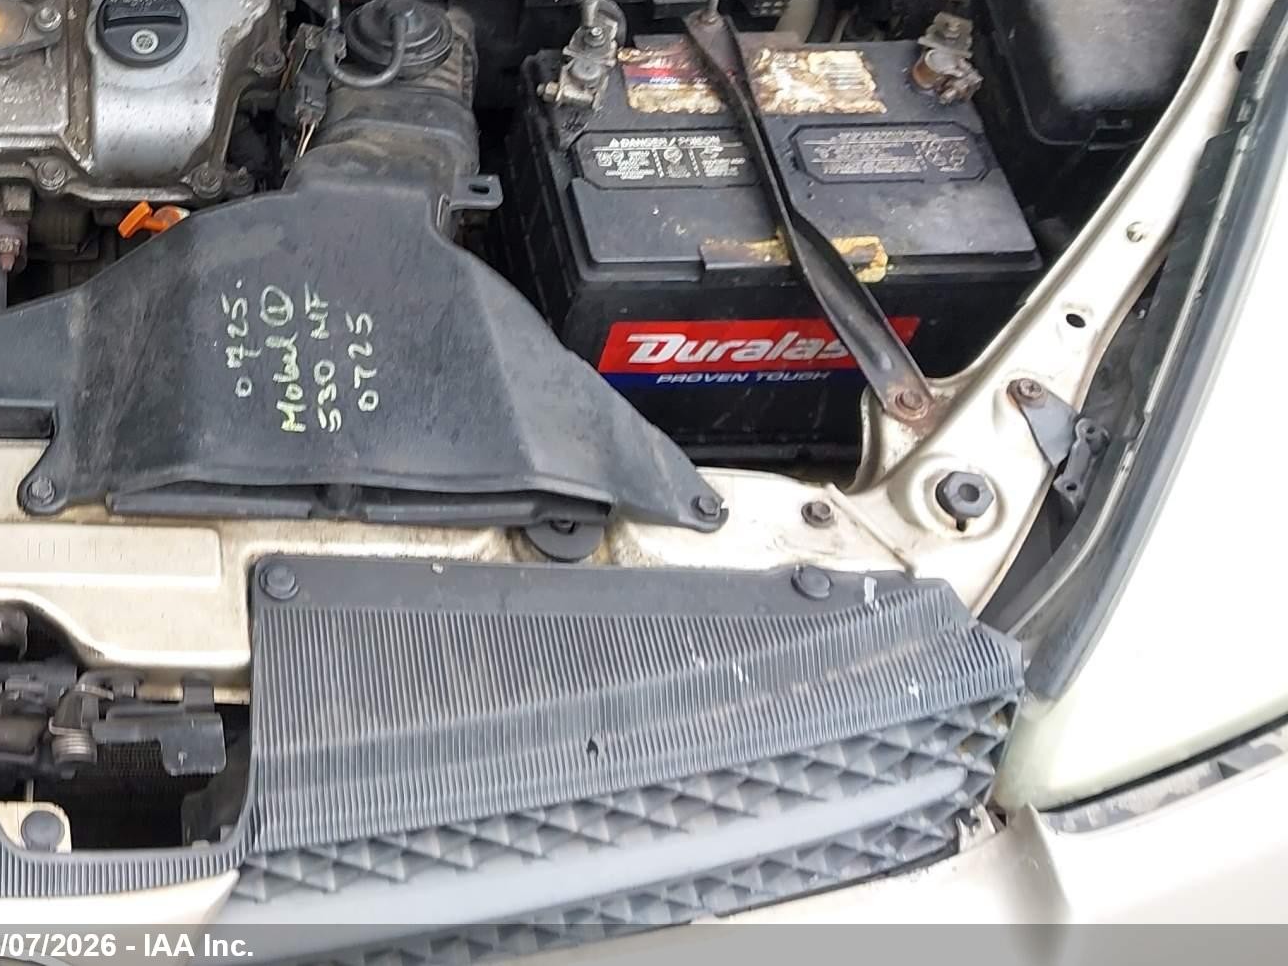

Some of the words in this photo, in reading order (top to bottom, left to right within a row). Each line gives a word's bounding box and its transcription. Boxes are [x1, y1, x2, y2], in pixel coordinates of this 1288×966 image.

[626, 331, 850, 364] Duralas
[656, 371, 750, 384] PROVEN
[756, 370, 831, 382] TOUGH
[314, 359, 342, 433] 530
